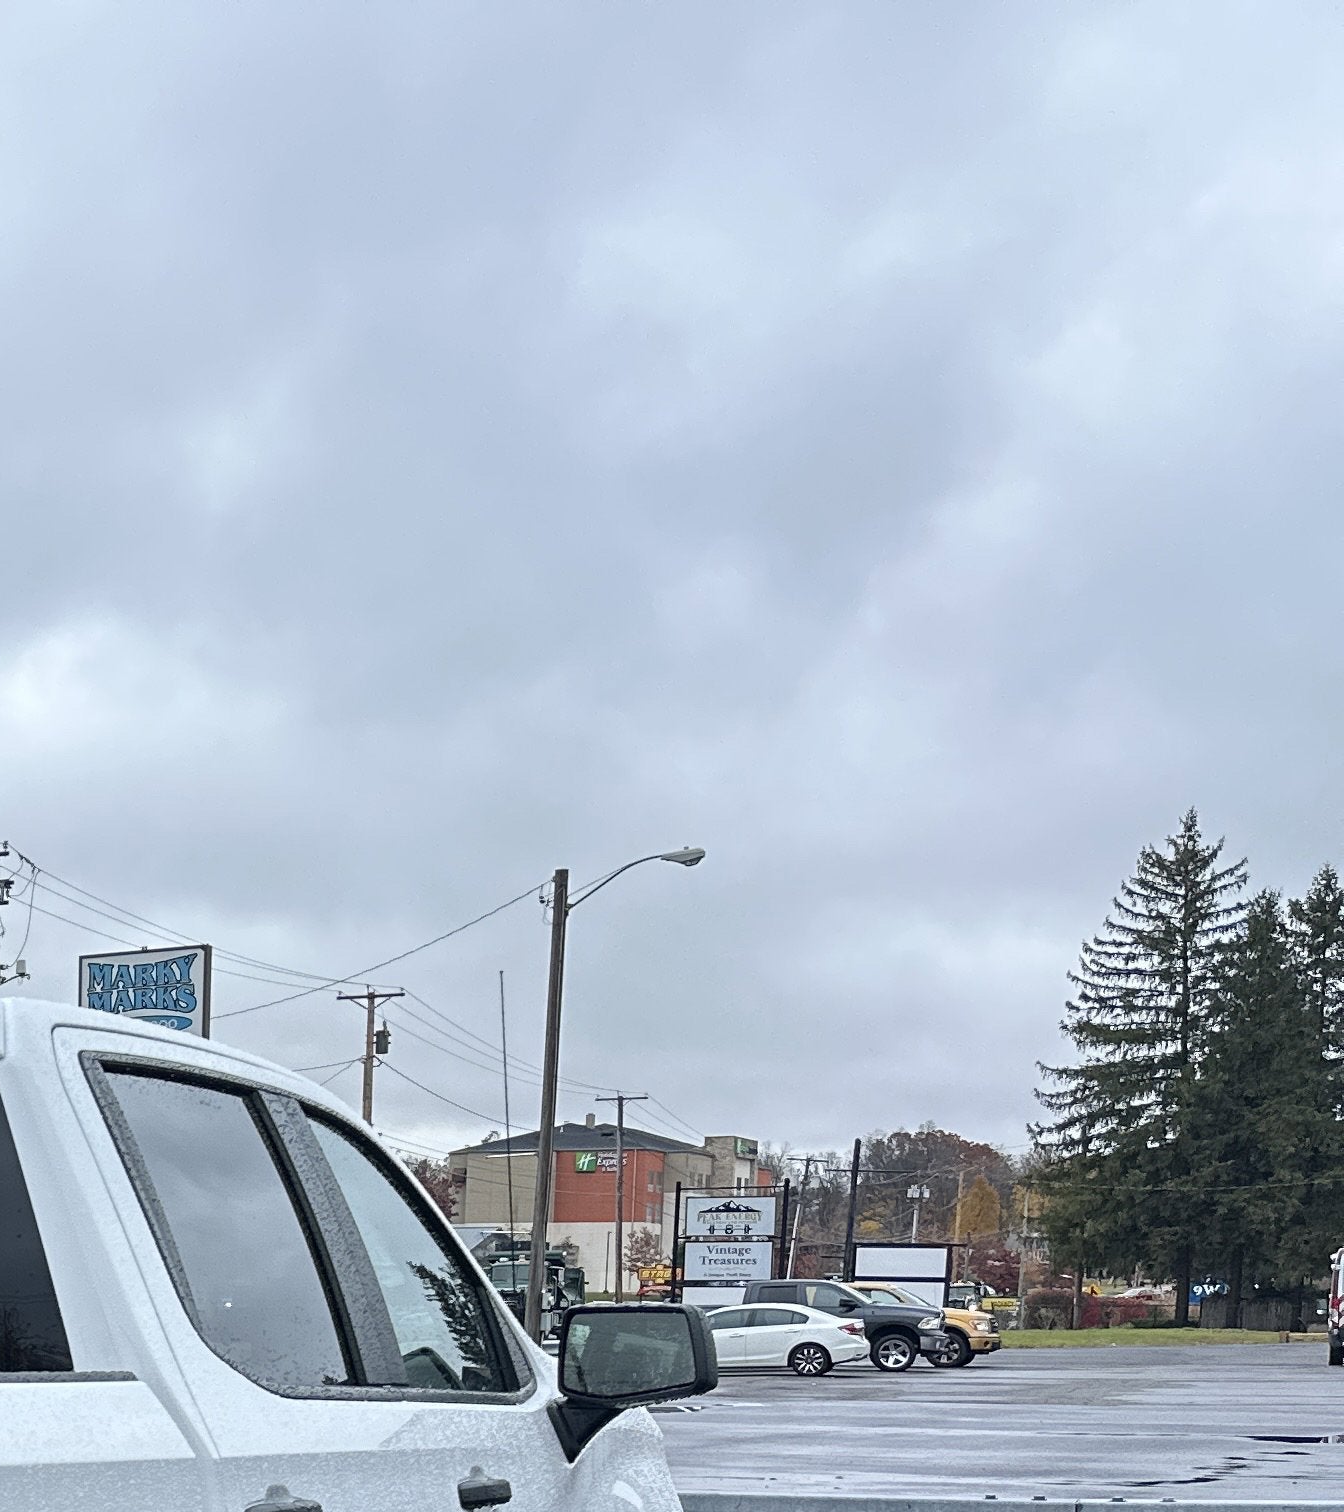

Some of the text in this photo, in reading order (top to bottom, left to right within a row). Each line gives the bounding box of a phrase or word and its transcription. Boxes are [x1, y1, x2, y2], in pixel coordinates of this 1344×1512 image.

[87, 953, 198, 992] MARKY
[87, 983, 198, 1014] MARKS
[697, 1212, 722, 1224] PEAK
[725, 1212, 763, 1222] ENERGY
[706, 1245, 752, 1257] Vintage
[698, 1255, 759, 1266] Treasures
